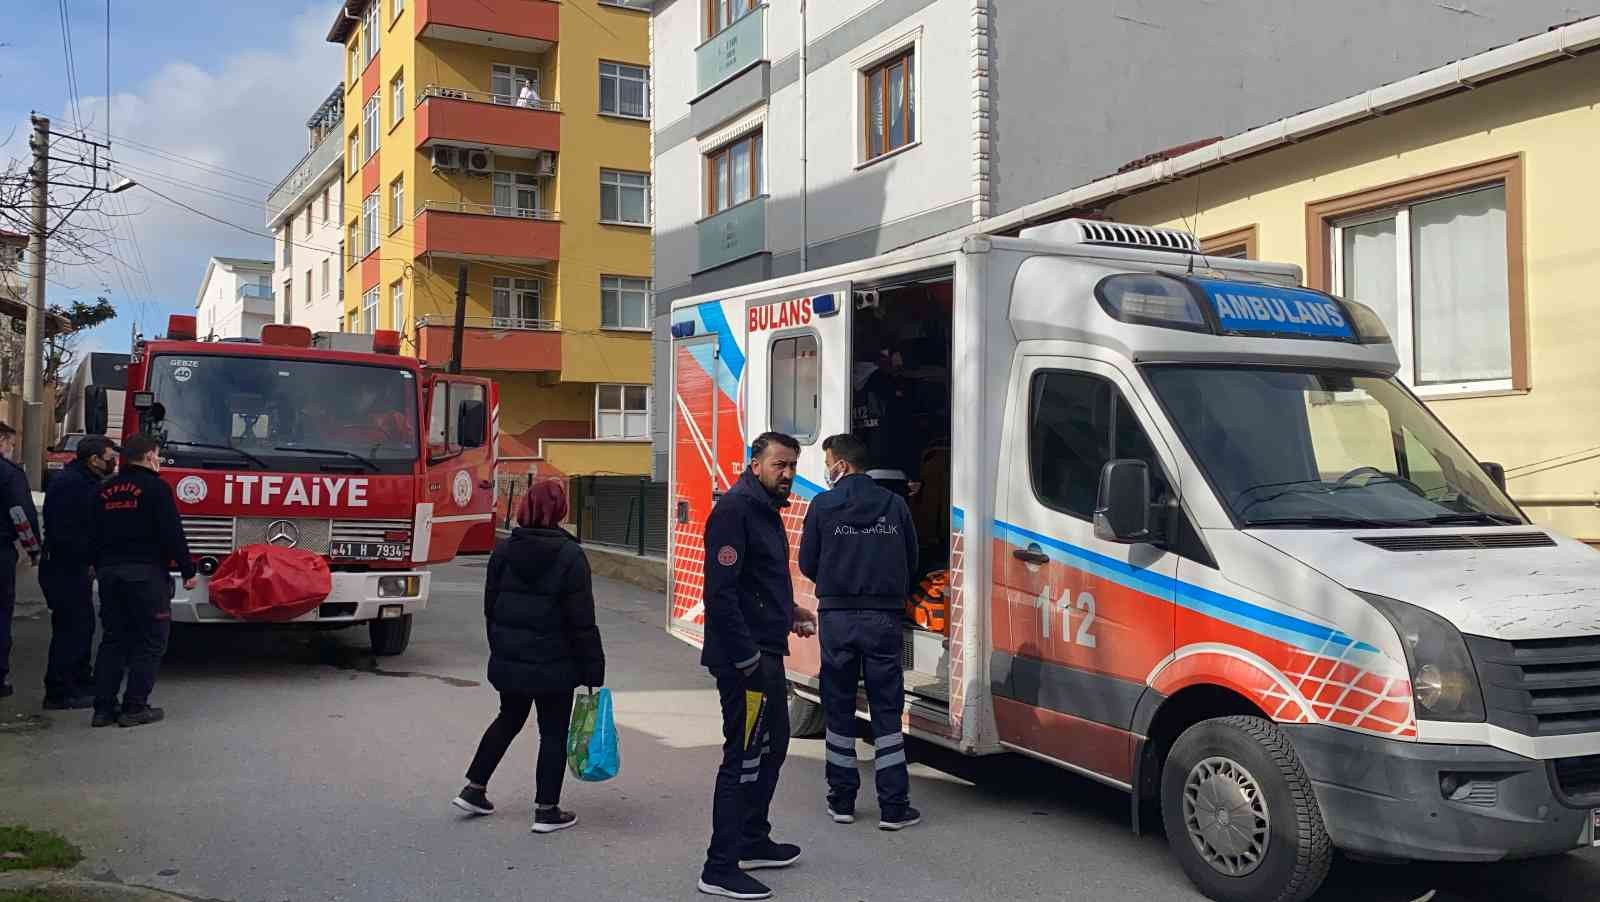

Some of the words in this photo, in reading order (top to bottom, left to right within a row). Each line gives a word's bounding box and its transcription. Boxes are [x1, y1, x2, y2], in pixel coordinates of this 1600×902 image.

[749, 297, 811, 332] BULANS
[1215, 293, 1345, 328] AMBULANS
[169, 359, 200, 368] GEBZE
[339, 543, 352, 556] 41
[360, 543, 368, 556] H
[376, 544, 402, 557] 7934
[1036, 584, 1097, 648] 112
